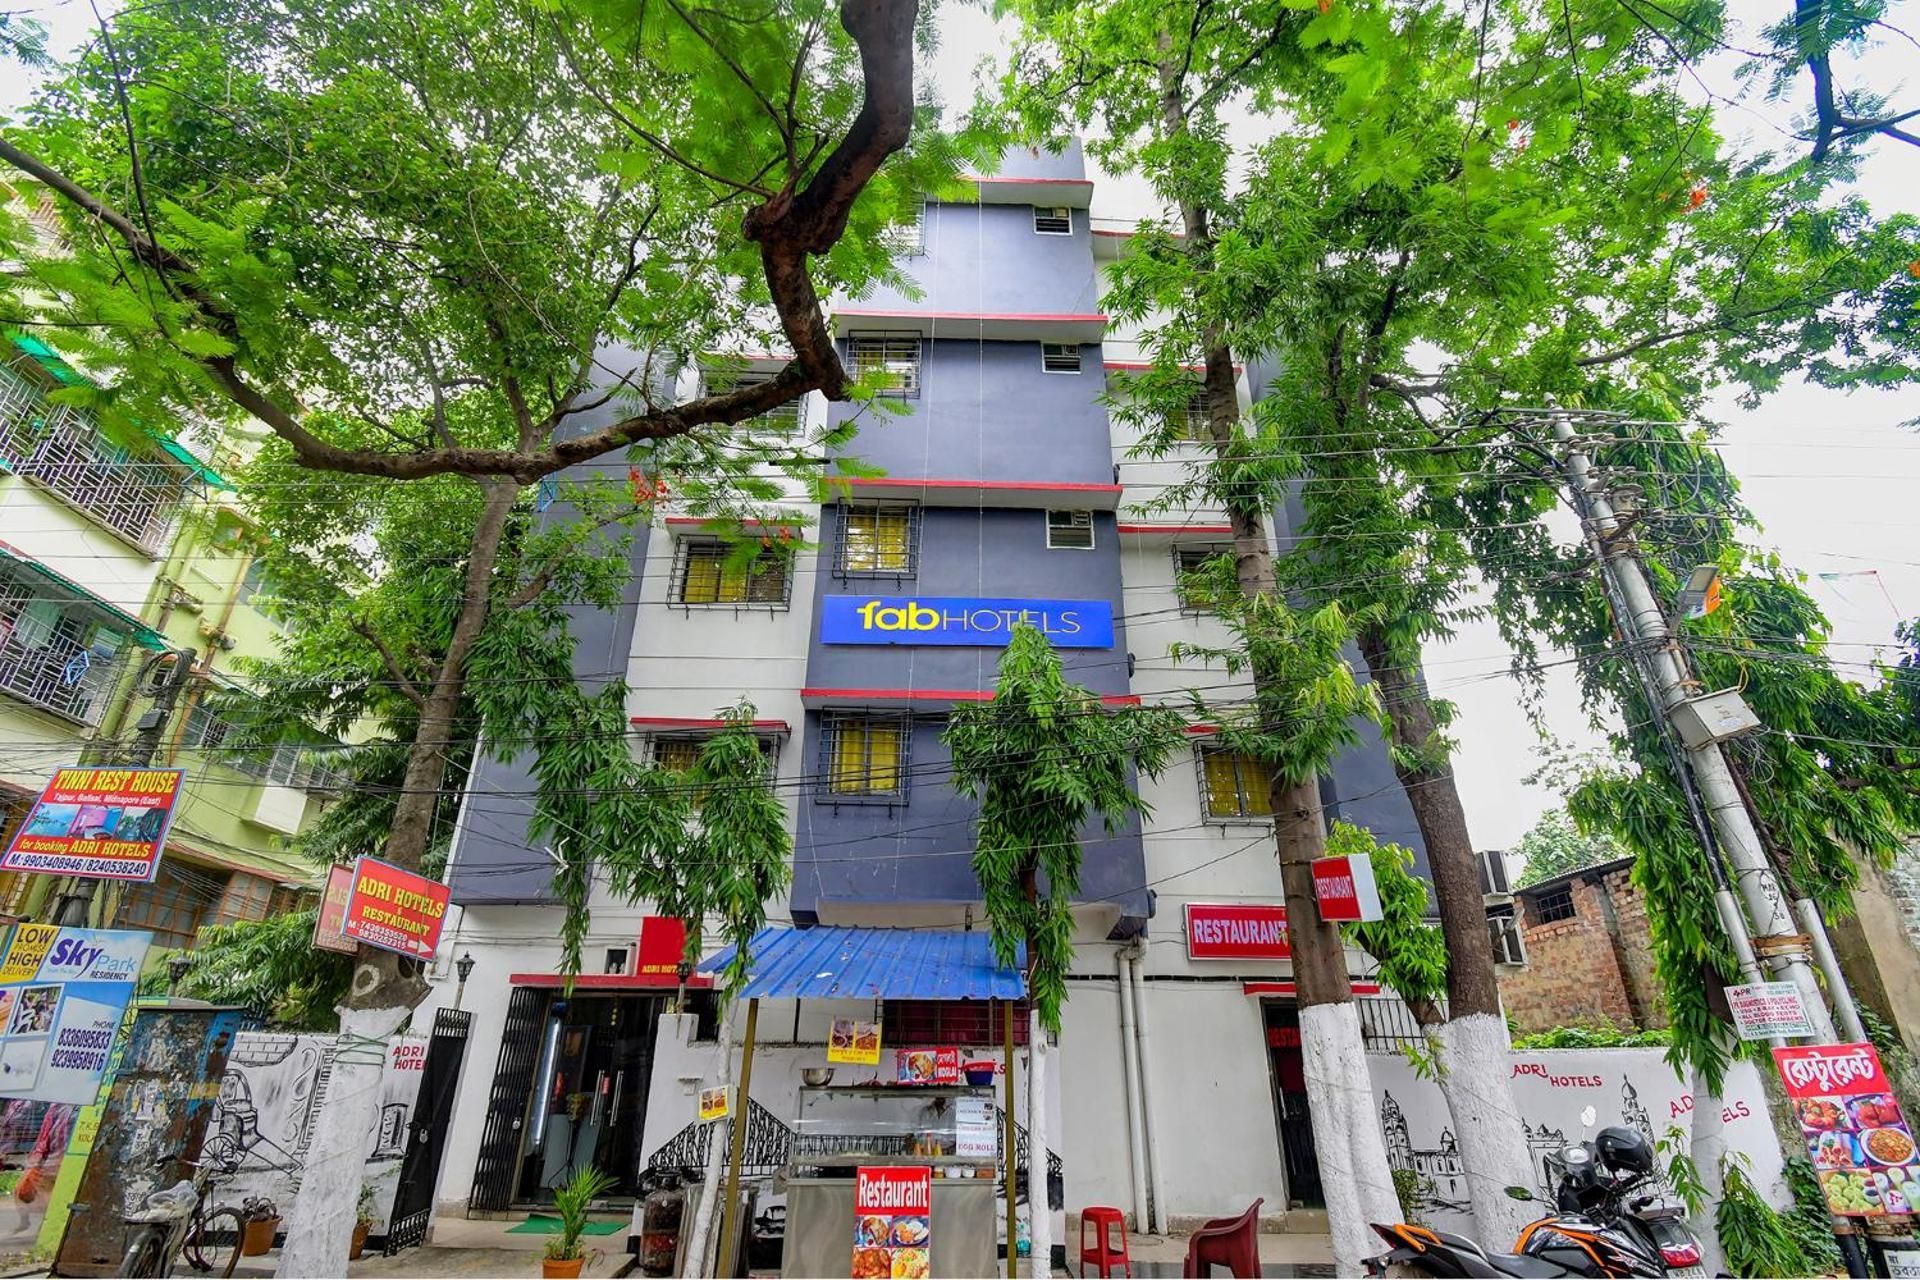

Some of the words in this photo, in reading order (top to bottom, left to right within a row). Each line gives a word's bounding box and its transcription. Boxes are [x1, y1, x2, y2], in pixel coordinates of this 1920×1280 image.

[55, 770, 93, 790] TINNI
[94, 771, 131, 792] REST
[132, 773, 176, 793] HOUSE
[19, 839, 34, 849] for
[33, 840, 68, 855] booking
[69, 840, 100, 853] ADRI
[101, 842, 151, 857] HOTELS
[357, 876, 391, 900] ADRI
[393, 886, 445, 919] HOTELS
[362, 906, 431, 936] RESTAURANT
[17, 927, 55, 944] LOW
[1193, 919, 1288, 945] RESTAURANT
[7, 952, 43, 967] HIGH
[95, 954, 137, 972] Park
[661, 964, 679, 974] HOT
[89, 970, 128, 980] RESIDENCY
[392, 1045, 425, 1057] ADRI
[1511, 1063, 1548, 1079] ADRI
[1550, 1075, 1603, 1087] HOTELS
[1782, 1048, 1874, 1092] রেস্টুরেন্ট
[858, 1173, 928, 1209] Restaurant
